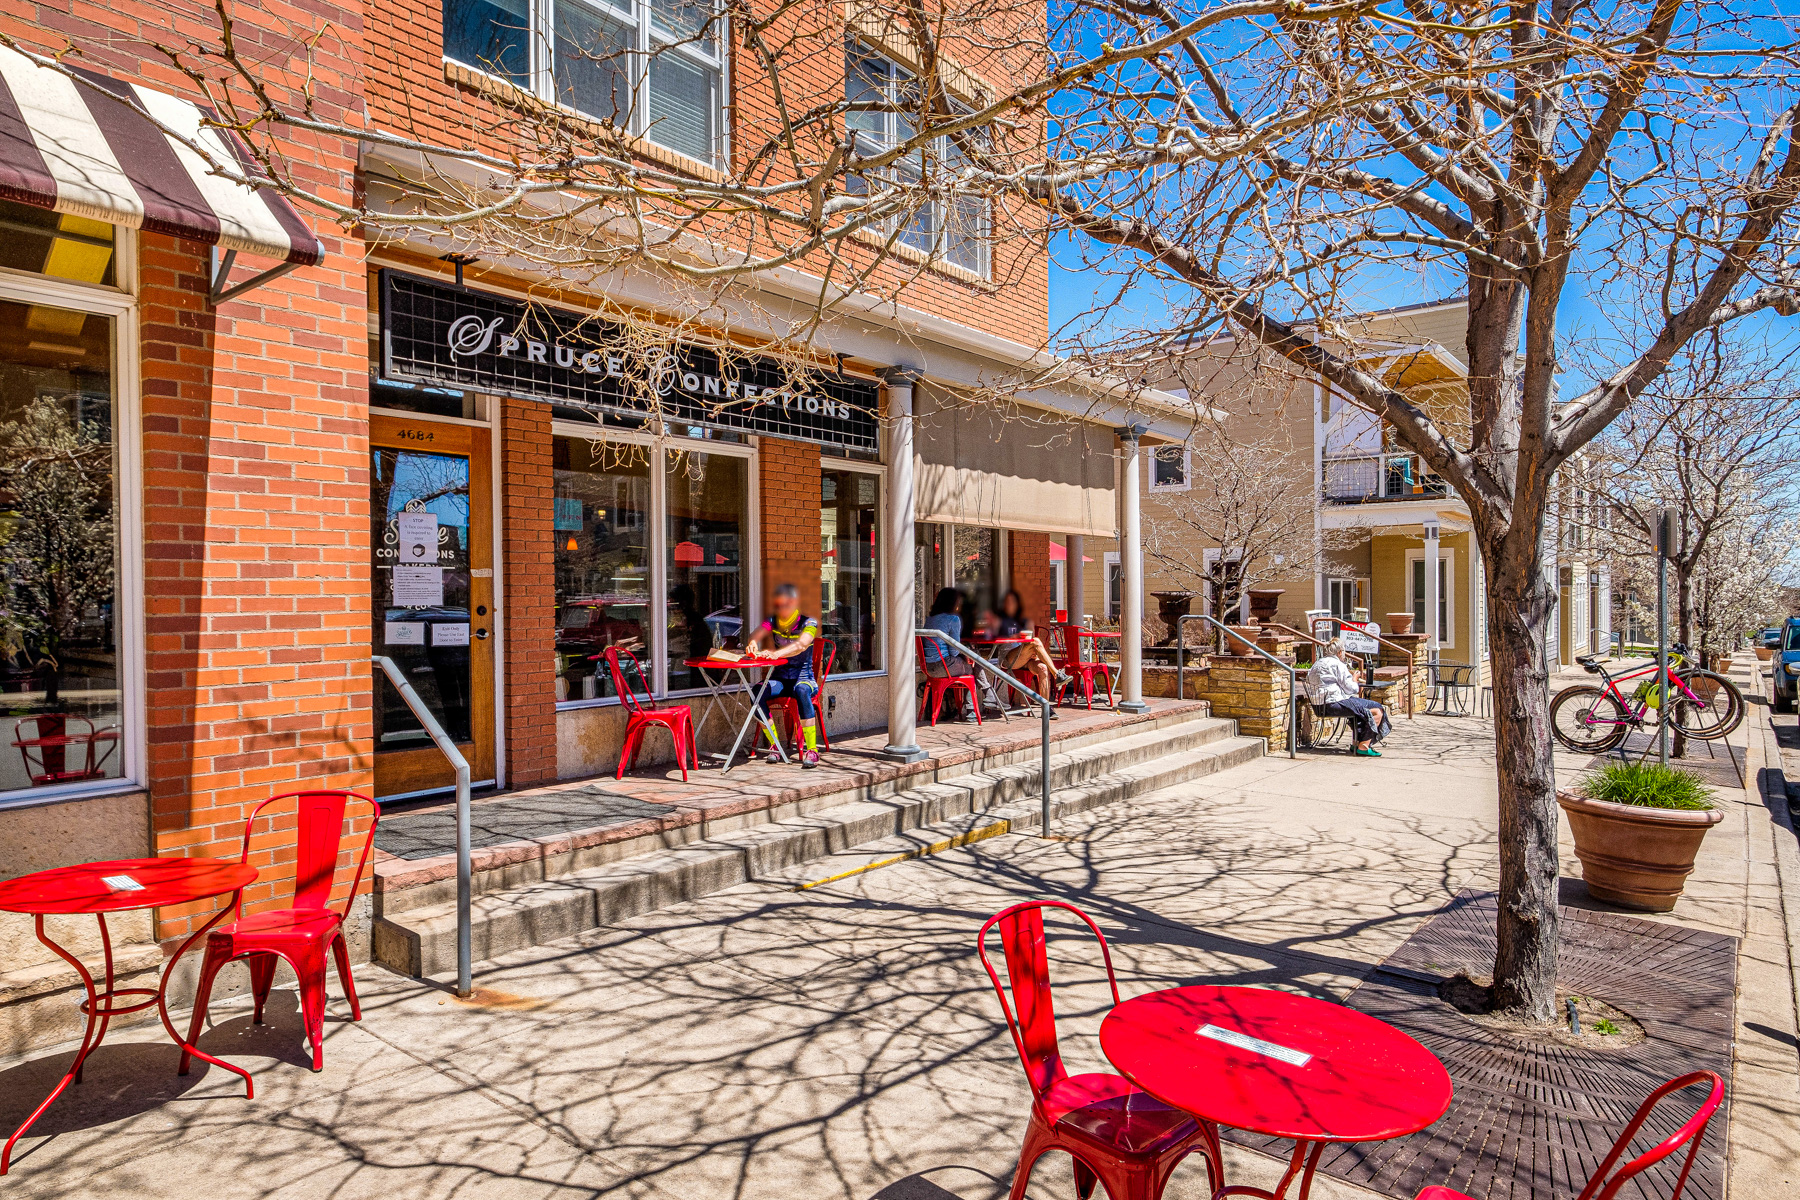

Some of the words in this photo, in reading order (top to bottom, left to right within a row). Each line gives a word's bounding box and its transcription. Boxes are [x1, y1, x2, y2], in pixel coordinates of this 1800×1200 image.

[447, 315, 624, 378] SPRUCE
[644, 347, 850, 420] CONFECTIONS
[397, 429, 435, 442] 4684
